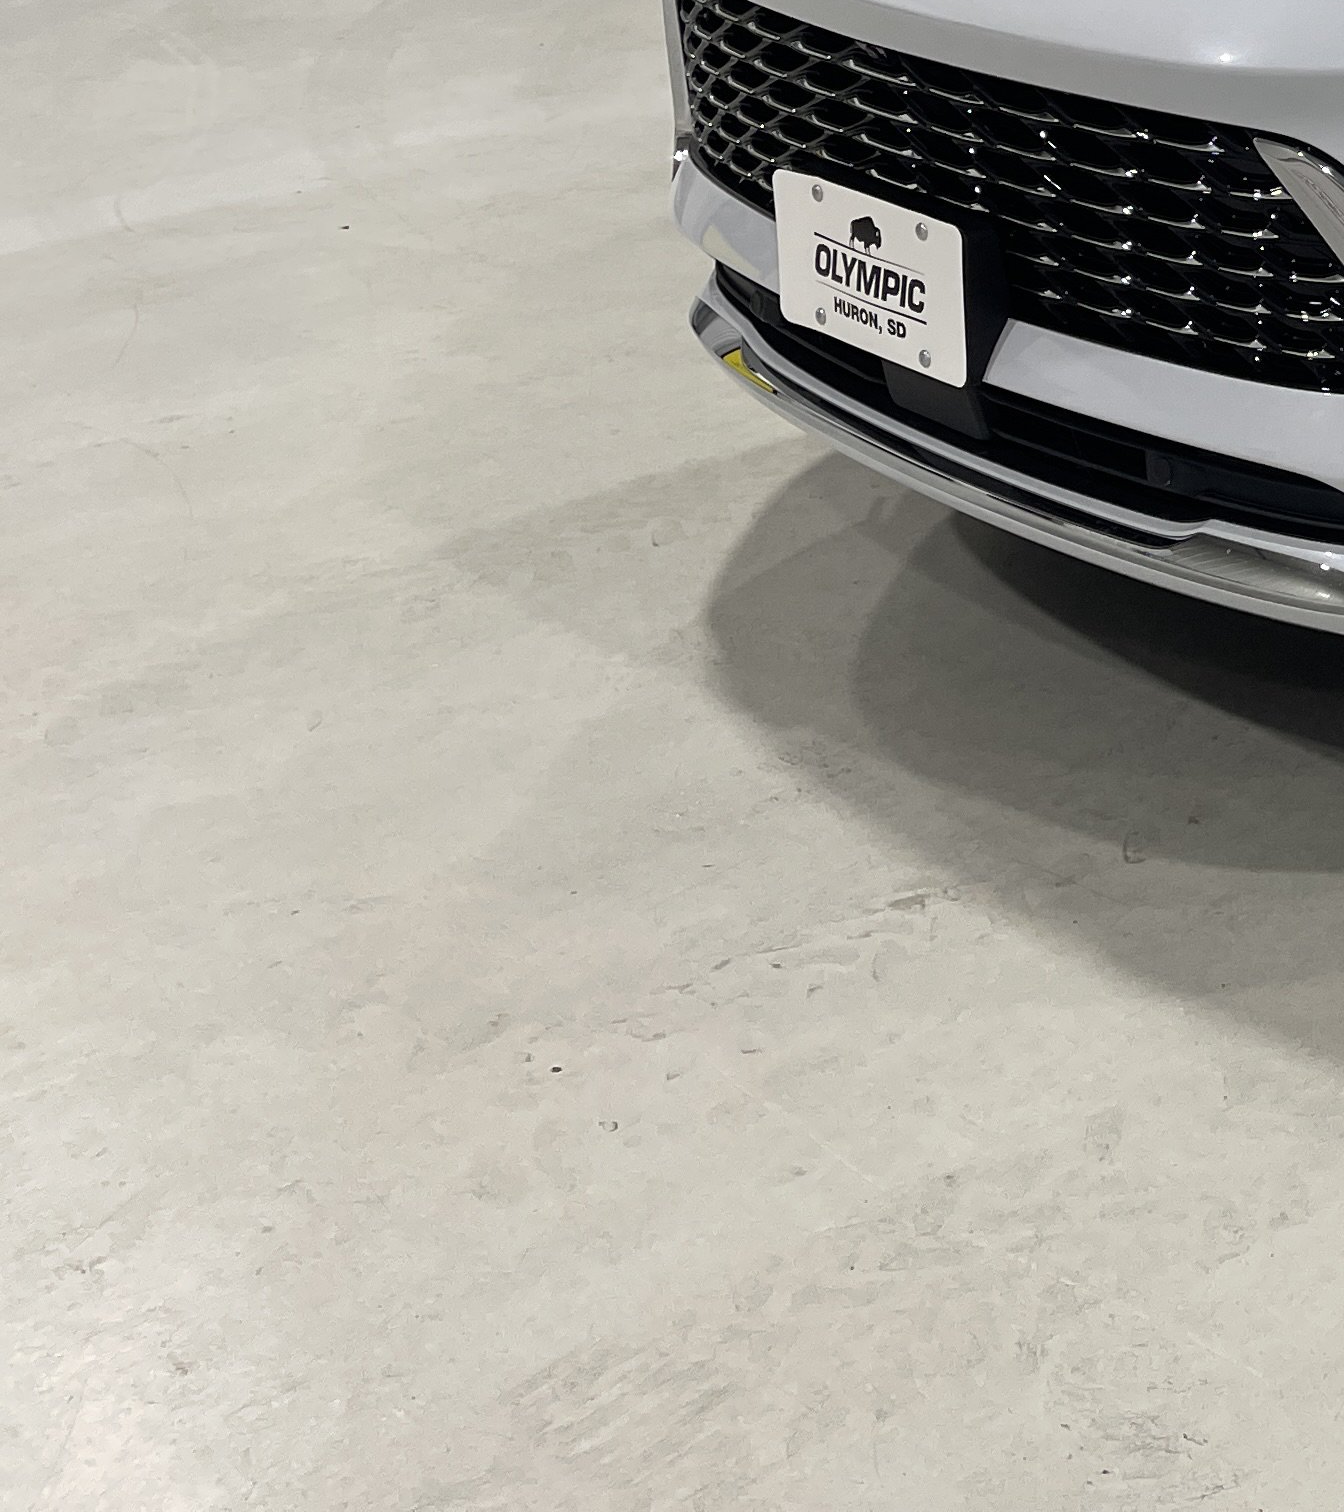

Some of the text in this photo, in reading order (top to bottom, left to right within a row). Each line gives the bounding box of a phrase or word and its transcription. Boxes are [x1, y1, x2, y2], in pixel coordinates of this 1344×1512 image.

[814, 243, 926, 314] OLYMPIC
[833, 296, 907, 339] HURON, SD
